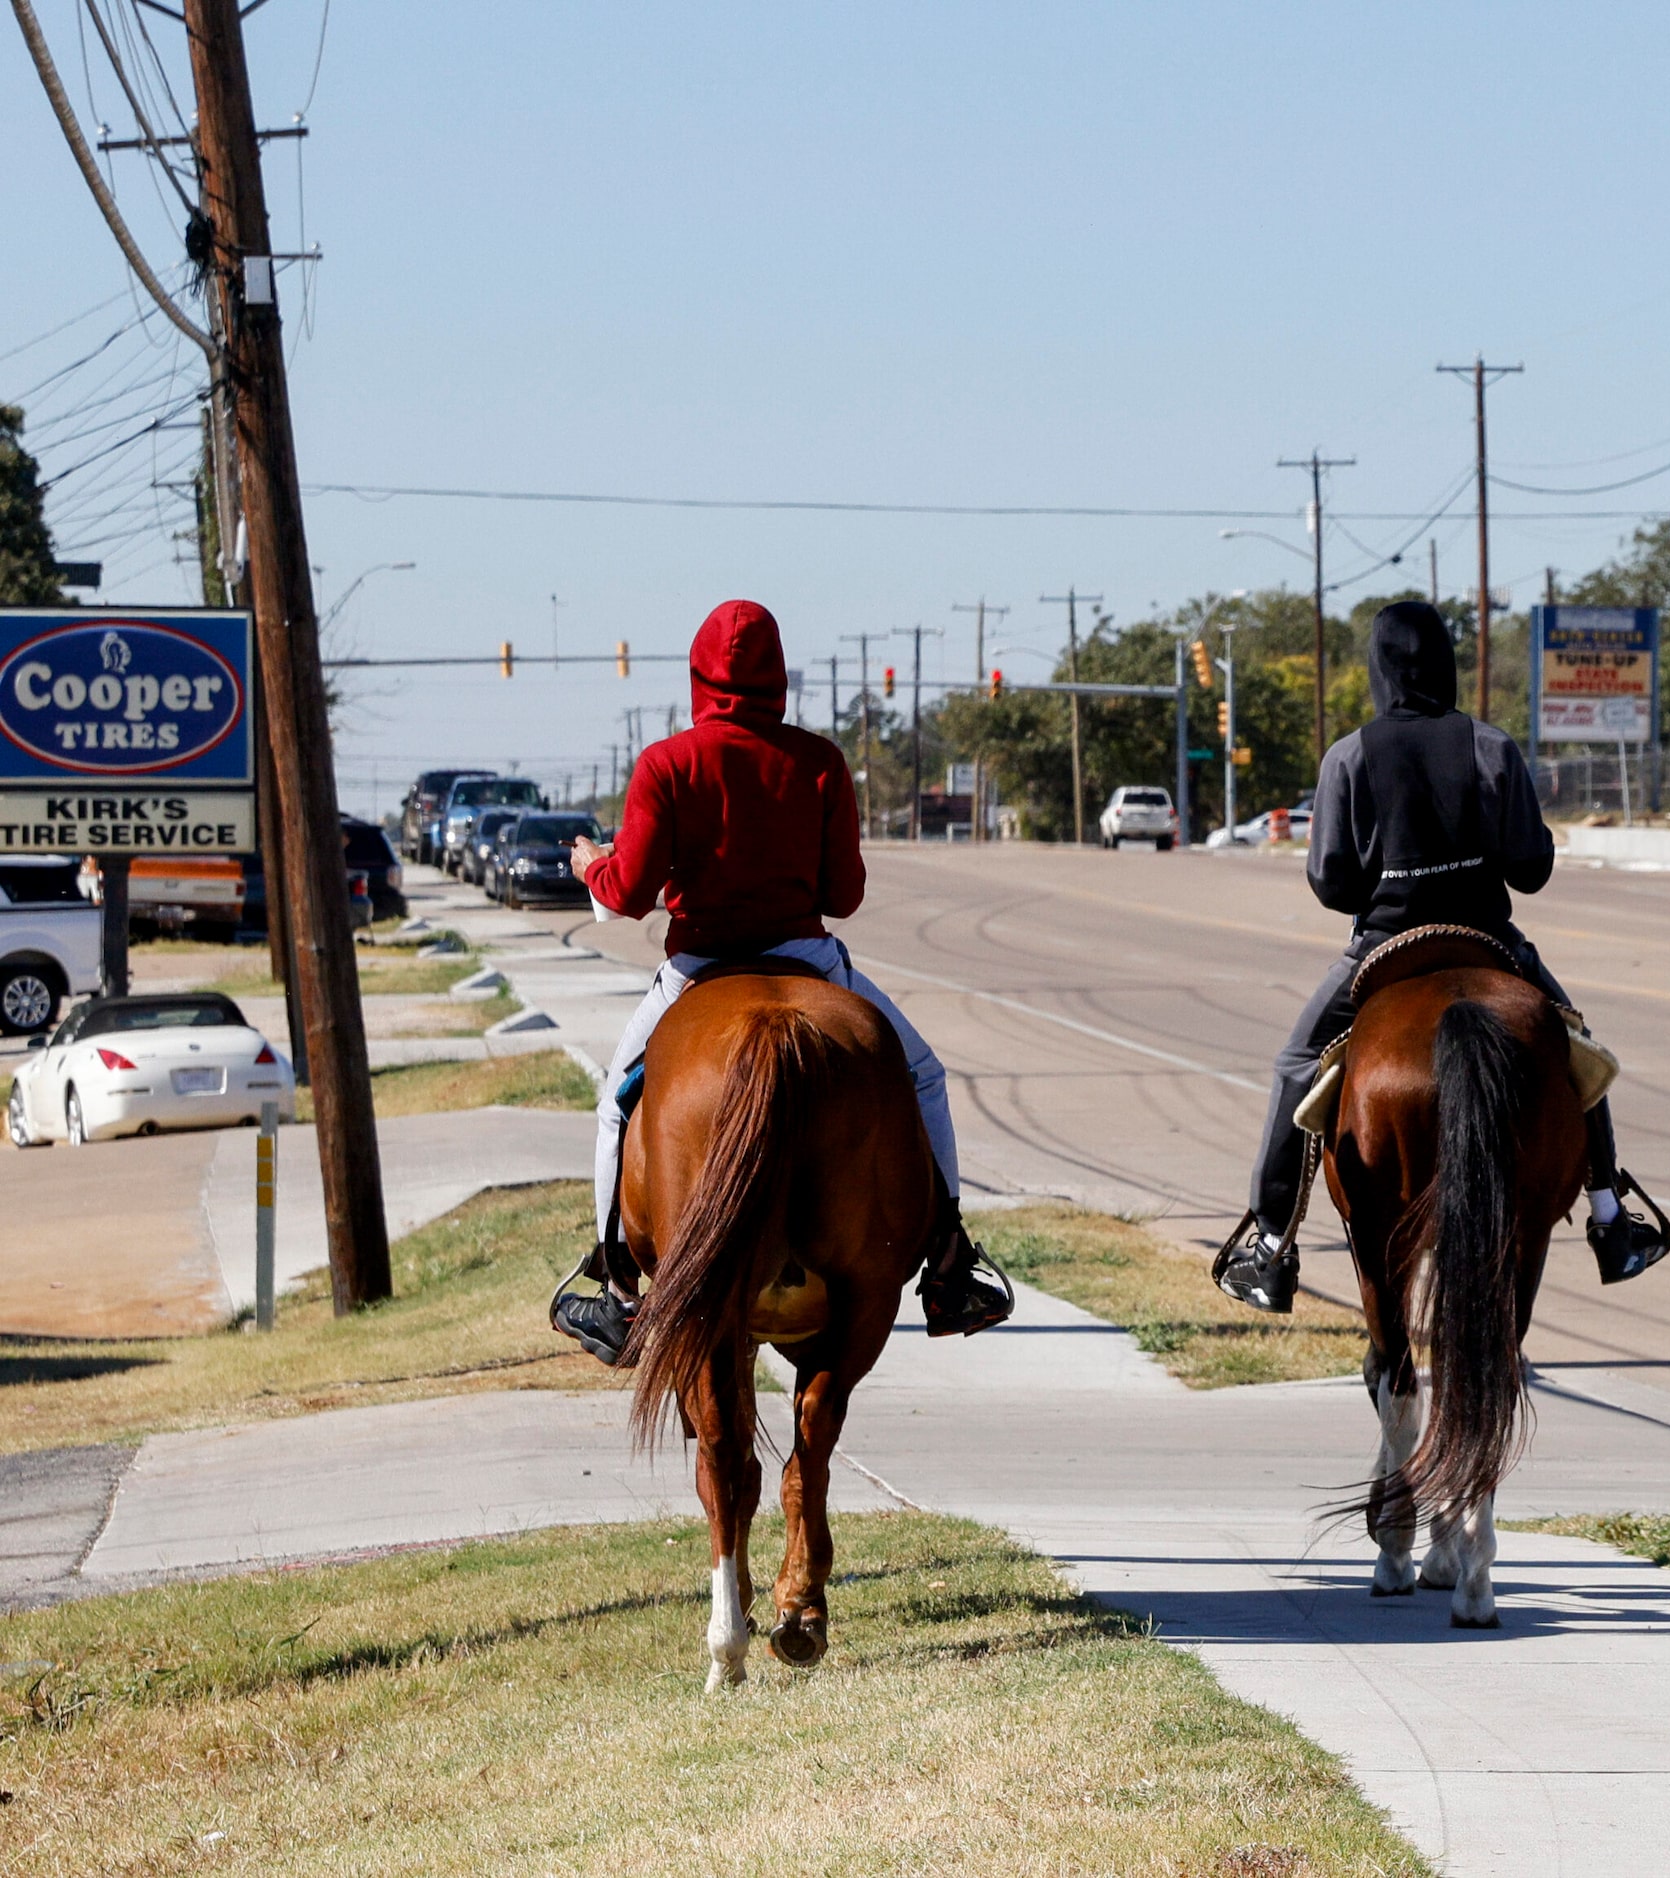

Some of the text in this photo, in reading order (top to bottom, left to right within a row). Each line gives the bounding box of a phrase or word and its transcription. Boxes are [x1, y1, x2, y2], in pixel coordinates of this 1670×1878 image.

[1555, 653, 1638, 667] TUNE-UP
[1575, 669, 1618, 680] STATE
[14, 662, 222, 721] Cooper
[1548, 681, 1644, 692] INSPECTION
[55, 722, 180, 749] TIRES
[47, 798, 189, 820] KIRK'S
[1, 824, 236, 846] TIRE SERVICE
[1388, 870, 1408, 878] OVER
[1410, 868, 1430, 877] YOUR
[1431, 864, 1448, 873] FEAR
[1450, 862, 1459, 870] OF
